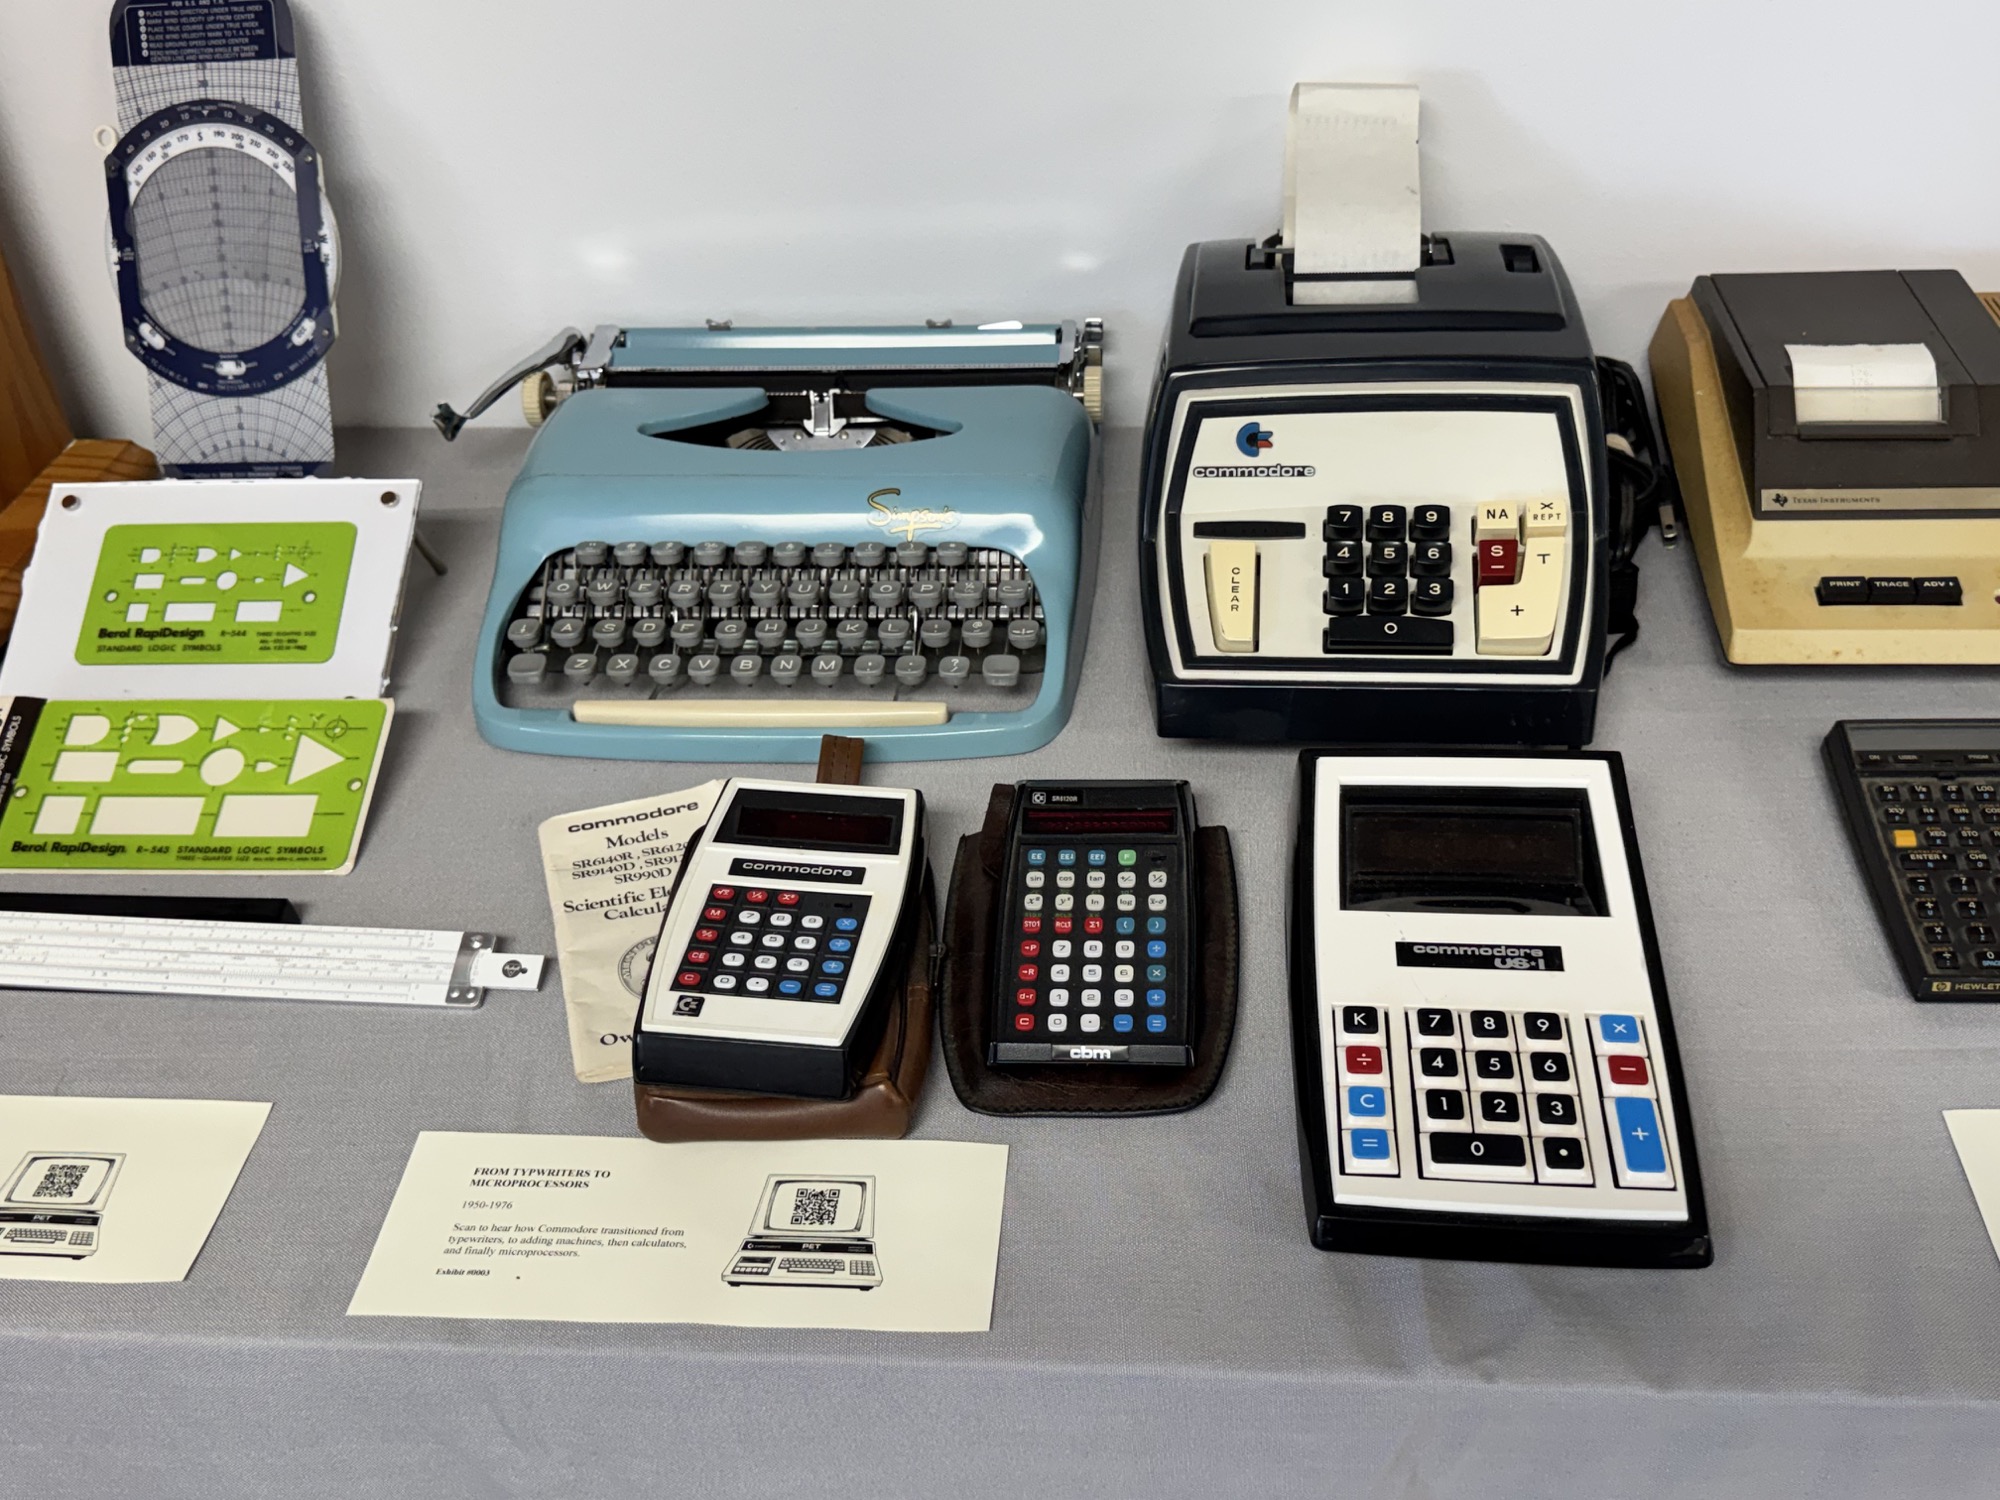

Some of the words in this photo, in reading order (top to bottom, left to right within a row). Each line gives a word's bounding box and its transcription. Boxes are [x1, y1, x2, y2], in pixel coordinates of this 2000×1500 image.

[223, 111, 233, 119] 10
[1194, 463, 1315, 477] commodore
[1340, 511, 1351, 522] 7
[1382, 511, 1394, 522] 8
[1426, 510, 1438, 522] 9
[1486, 508, 1509, 520] NA
[1533, 513, 1561, 521] REPT
[1338, 548, 1350, 559] 4
[1384, 548, 1395, 559] 5
[1428, 548, 1439, 559] 6
[1490, 545, 1503, 556] S
[1537, 554, 1550, 564] T
[597, 582, 612, 591] W
[637, 584, 651, 592] E
[677, 584, 692, 593] R
[719, 584, 732, 593] T
[760, 584, 773, 592] Y
[920, 585, 933, 593] P
[1230, 567, 1241, 612] CLEAR
[1343, 583, 1350, 594] 1
[1384, 583, 1395, 594] 2
[1429, 583, 1441, 595] 3
[98, 628, 131, 638] Berol
[135, 628, 205, 640] RapiDesign
[97, 644, 143, 652] STANDARD
[148, 644, 176, 652] LOGIC
[182, 643, 222, 651] SYMBOLS
[574, 659, 588, 668] Z
[615, 659, 630, 669] X
[658, 659, 671, 669] C
[698, 659, 710, 669] V
[739, 660, 753, 669] B
[779, 660, 794, 669] N
[818, 660, 835, 670] M
[567, 801, 699, 833] commodore
[605, 828, 669, 849] Models
[11, 841, 47, 853] Berol
[51, 841, 127, 856] RapiDesign
[177, 846, 232, 854] STANDARD
[238, 846, 272, 854] LOGIC
[277, 846, 324, 854] SYMBOLS
[742, 861, 853, 877] commodore
[614, 867, 672, 884] SR990D
[563, 888, 646, 913] Scientific
[1413, 944, 1544, 957] commodore
[1354, 1013, 1367, 1025] K
[1429, 1015, 1441, 1027] 7
[1484, 1017, 1495, 1030] 8
[1537, 1019, 1549, 1031] 9
[1069, 1046, 1111, 1059] cbm
[1432, 1055, 1444, 1069] 4
[1489, 1057, 1500, 1071] 5
[1545, 1059, 1557, 1073] 6
[1361, 1093, 1374, 1108] C
[1441, 1097, 1447, 1110] 1
[1494, 1100, 1507, 1113] 2
[1551, 1102, 1563, 1115] 3
[1471, 1142, 1484, 1156] 0
[473, 1167, 510, 1177] FROM
[513, 1167, 591, 1178] TYPWRITERS
[594, 1170, 611, 1178] TO
[469, 1178, 590, 1188] MICROPROCESSORS
[462, 1200, 513, 1210] 1950-1976
[32, 1214, 52, 1222] PET
[453, 1223, 477, 1232] Scan
[479, 1224, 488, 1232] to
[491, 1223, 512, 1232] hear
[515, 1224, 535, 1233] how
[538, 1224, 598, 1234] Commodore
[601, 1226, 658, 1236] transitioned
[661, 1227, 685, 1237] from
[448, 1235, 504, 1245] typewriters,
[508, 1236, 517, 1244] to
[520, 1236, 553, 1247] adding
[556, 1237, 604, 1247] machines,
[608, 1239, 629, 1247] then
[631, 1239, 687, 1248] calculators,
[443, 1246, 462, 1255] and
[464, 1246, 496, 1257] finally
[498, 1248, 581, 1258] microprocessors.
[435, 1268, 465, 1276] Exhibit
